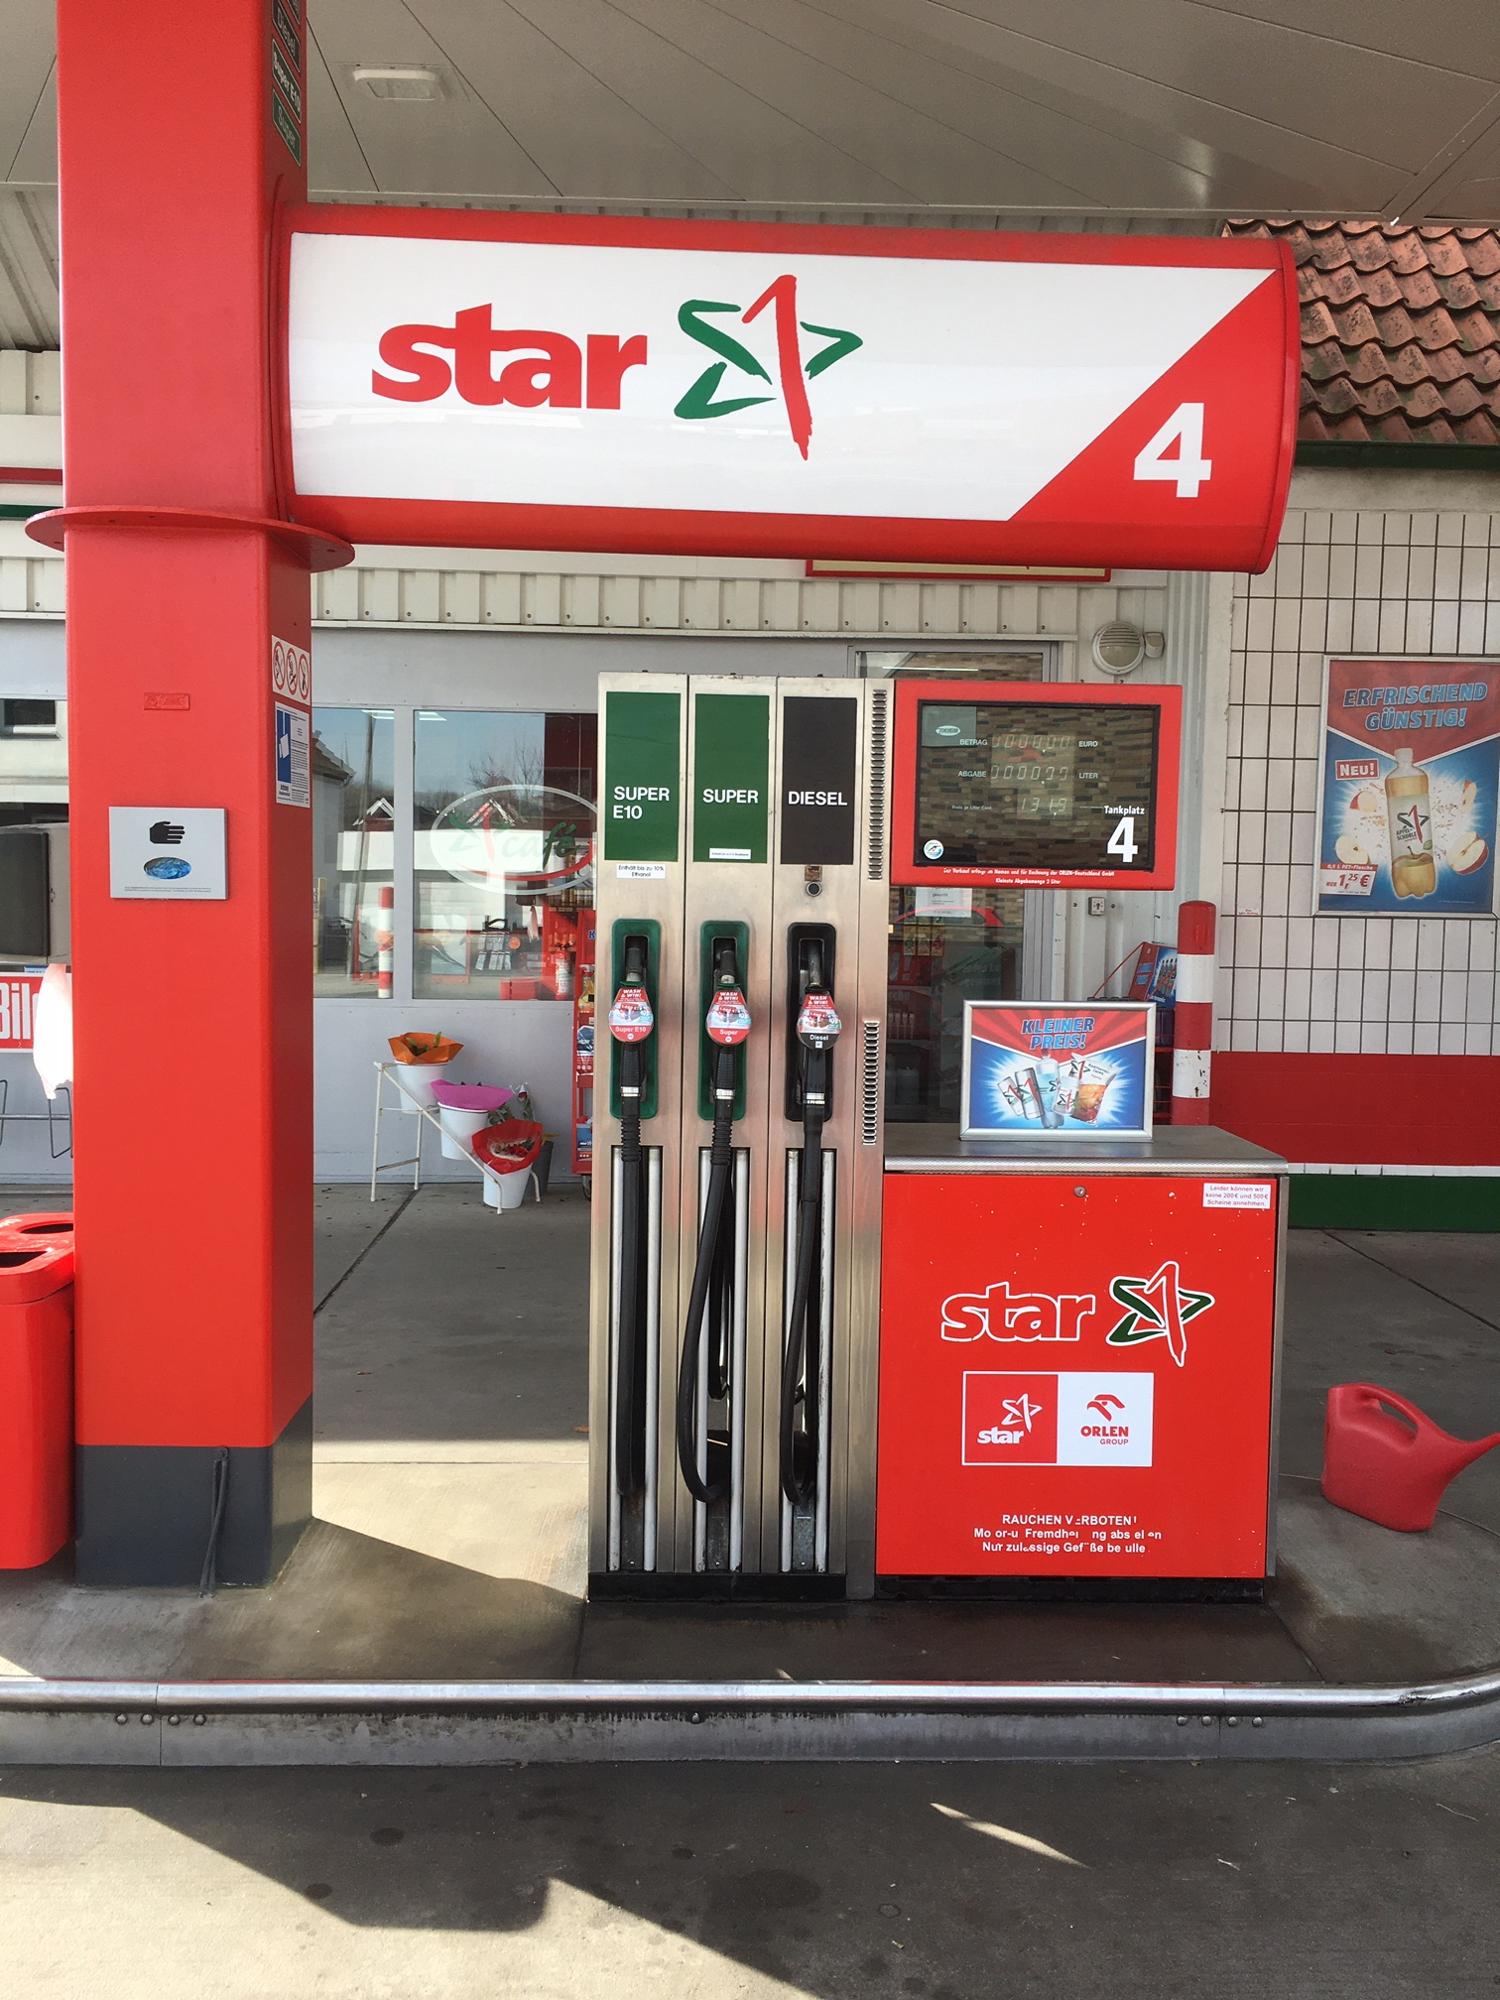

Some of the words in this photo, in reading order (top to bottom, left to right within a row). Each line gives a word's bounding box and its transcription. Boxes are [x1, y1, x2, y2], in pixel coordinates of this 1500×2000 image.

[372, 303, 647, 409] star
[1133, 402, 1212, 497] 4
[1343, 682, 1488, 708] ERFRISCHEND
[1364, 706, 1467, 731] GÜNSTIG!
[959, 738, 988, 746] BETRAG
[1078, 740, 1099, 748] EURO
[958, 770, 987, 778] ABGABE
[613, 786, 670, 801] SUPER
[702, 788, 759, 804] SUPER
[788, 790, 848, 806] DIESEL
[613, 805, 643, 819] E10
[1103, 805, 1145, 816] Tankplatz
[502, 821, 577, 871] café
[1107, 816, 1139, 863] 4
[1360, 874, 1370, 887] €
[0, 982, 38, 1040] Bil
[1021, 1017, 1095, 1035] KLEINER
[1030, 1034, 1087, 1050] PREIS!
[941, 1281, 1096, 1342] star
[976, 1426, 1025, 1445] star
[1080, 1425, 1129, 1437] ORLEN
[1002, 1514, 1062, 1525] RAUCHEN
[982, 1542, 1003, 1552] Nur
[1063, 1542, 1103, 1553] Gefße
